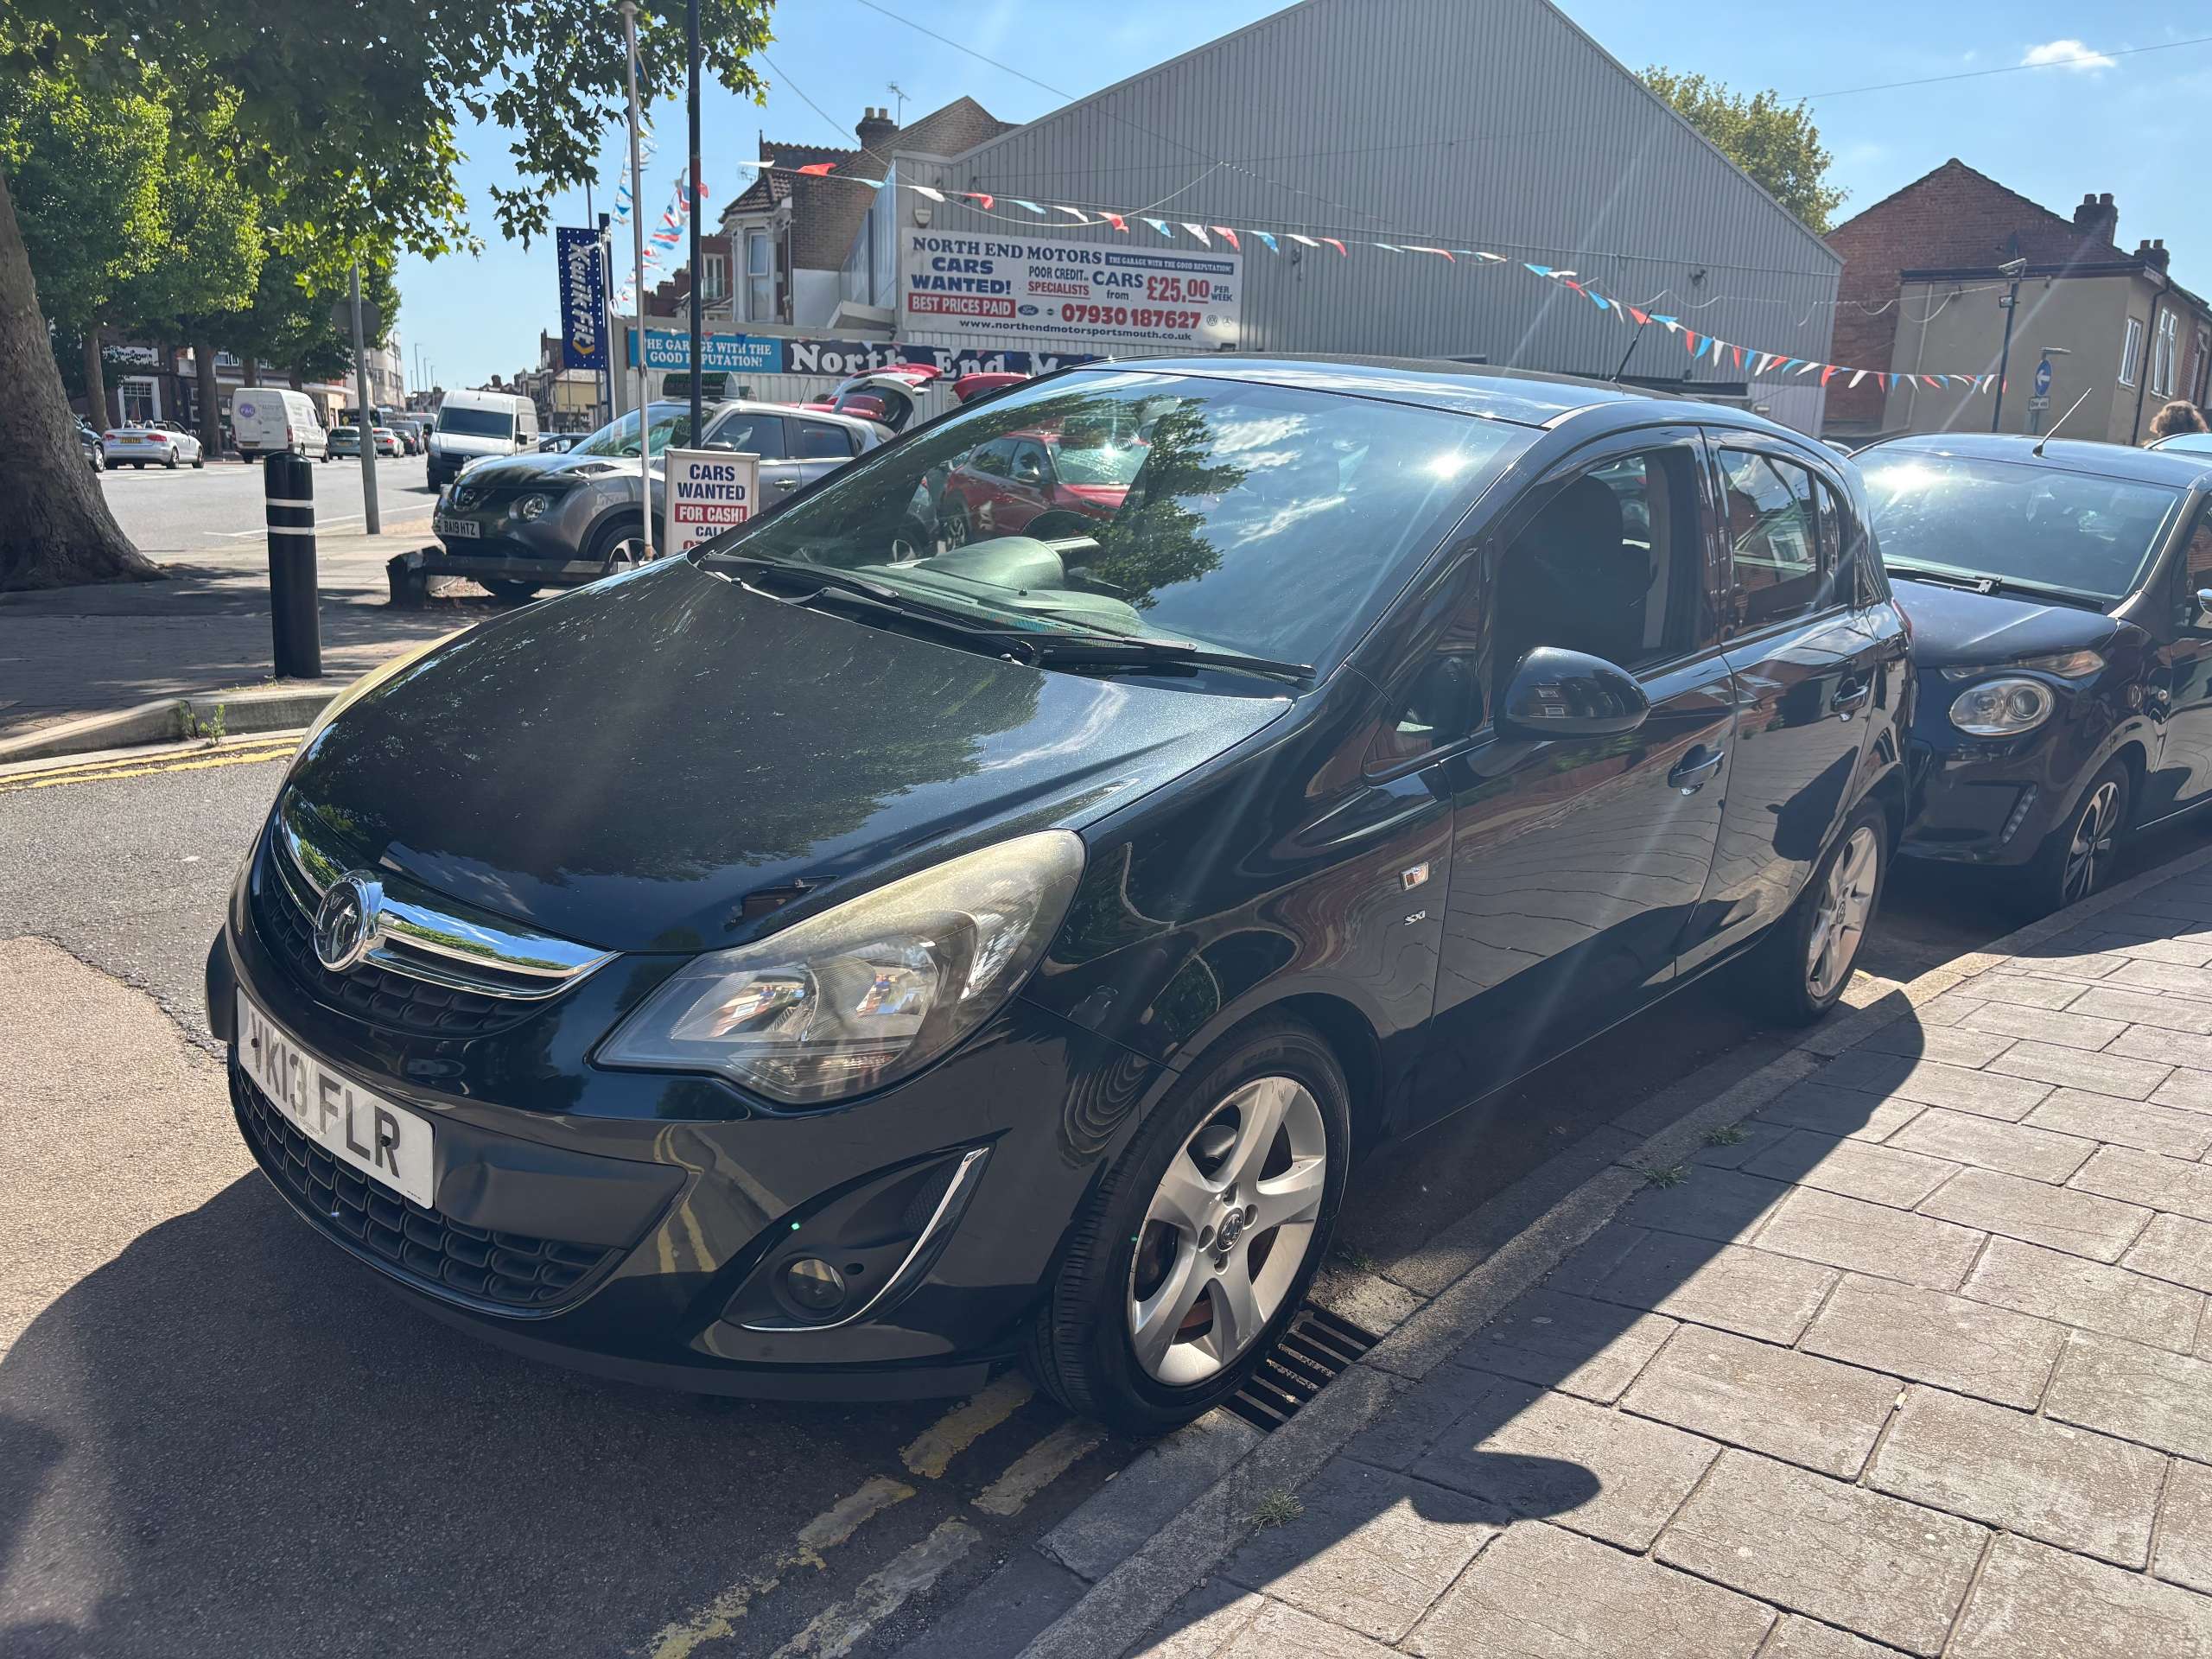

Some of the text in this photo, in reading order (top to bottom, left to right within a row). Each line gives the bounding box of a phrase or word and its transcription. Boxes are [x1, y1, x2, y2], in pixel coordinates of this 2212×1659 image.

[912, 237, 1103, 264] NORTH END MOTORS
[931, 257, 994, 275] CARS
[1029, 265, 1052, 278] POOR
[1122, 257, 1147, 265] GARAGE
[1176, 261, 1193, 270] GOOD
[911, 274, 1011, 295] WANTED!
[1028, 281, 1090, 296] SPECIALISTS
[1092, 270, 1210, 303] CARS £25.00
[1213, 285, 1230, 294] PER
[568, 242, 595, 346] Kwik Fit
[1106, 289, 1129, 301] from
[1211, 293, 1233, 302] WEEK
[912, 296, 1011, 315] BEST PRICES PAID
[1061, 303, 1201, 329] 07930 187627
[959, 321, 1192, 340] www.northendmotorsportsmouth.co.uk
[645, 338, 772, 355] HE GARGE WITH THE
[650, 351, 762, 366] GOOD PUTATION!
[790, 343, 907, 373] North
[933, 351, 1005, 378] End
[690, 463, 735, 481] CARS
[677, 482, 746, 500] WANTED
[679, 505, 743, 523] FOR CASH!
[444, 520, 475, 536] BA19 HTZ
[319, 1073, 400, 1179] FLR
